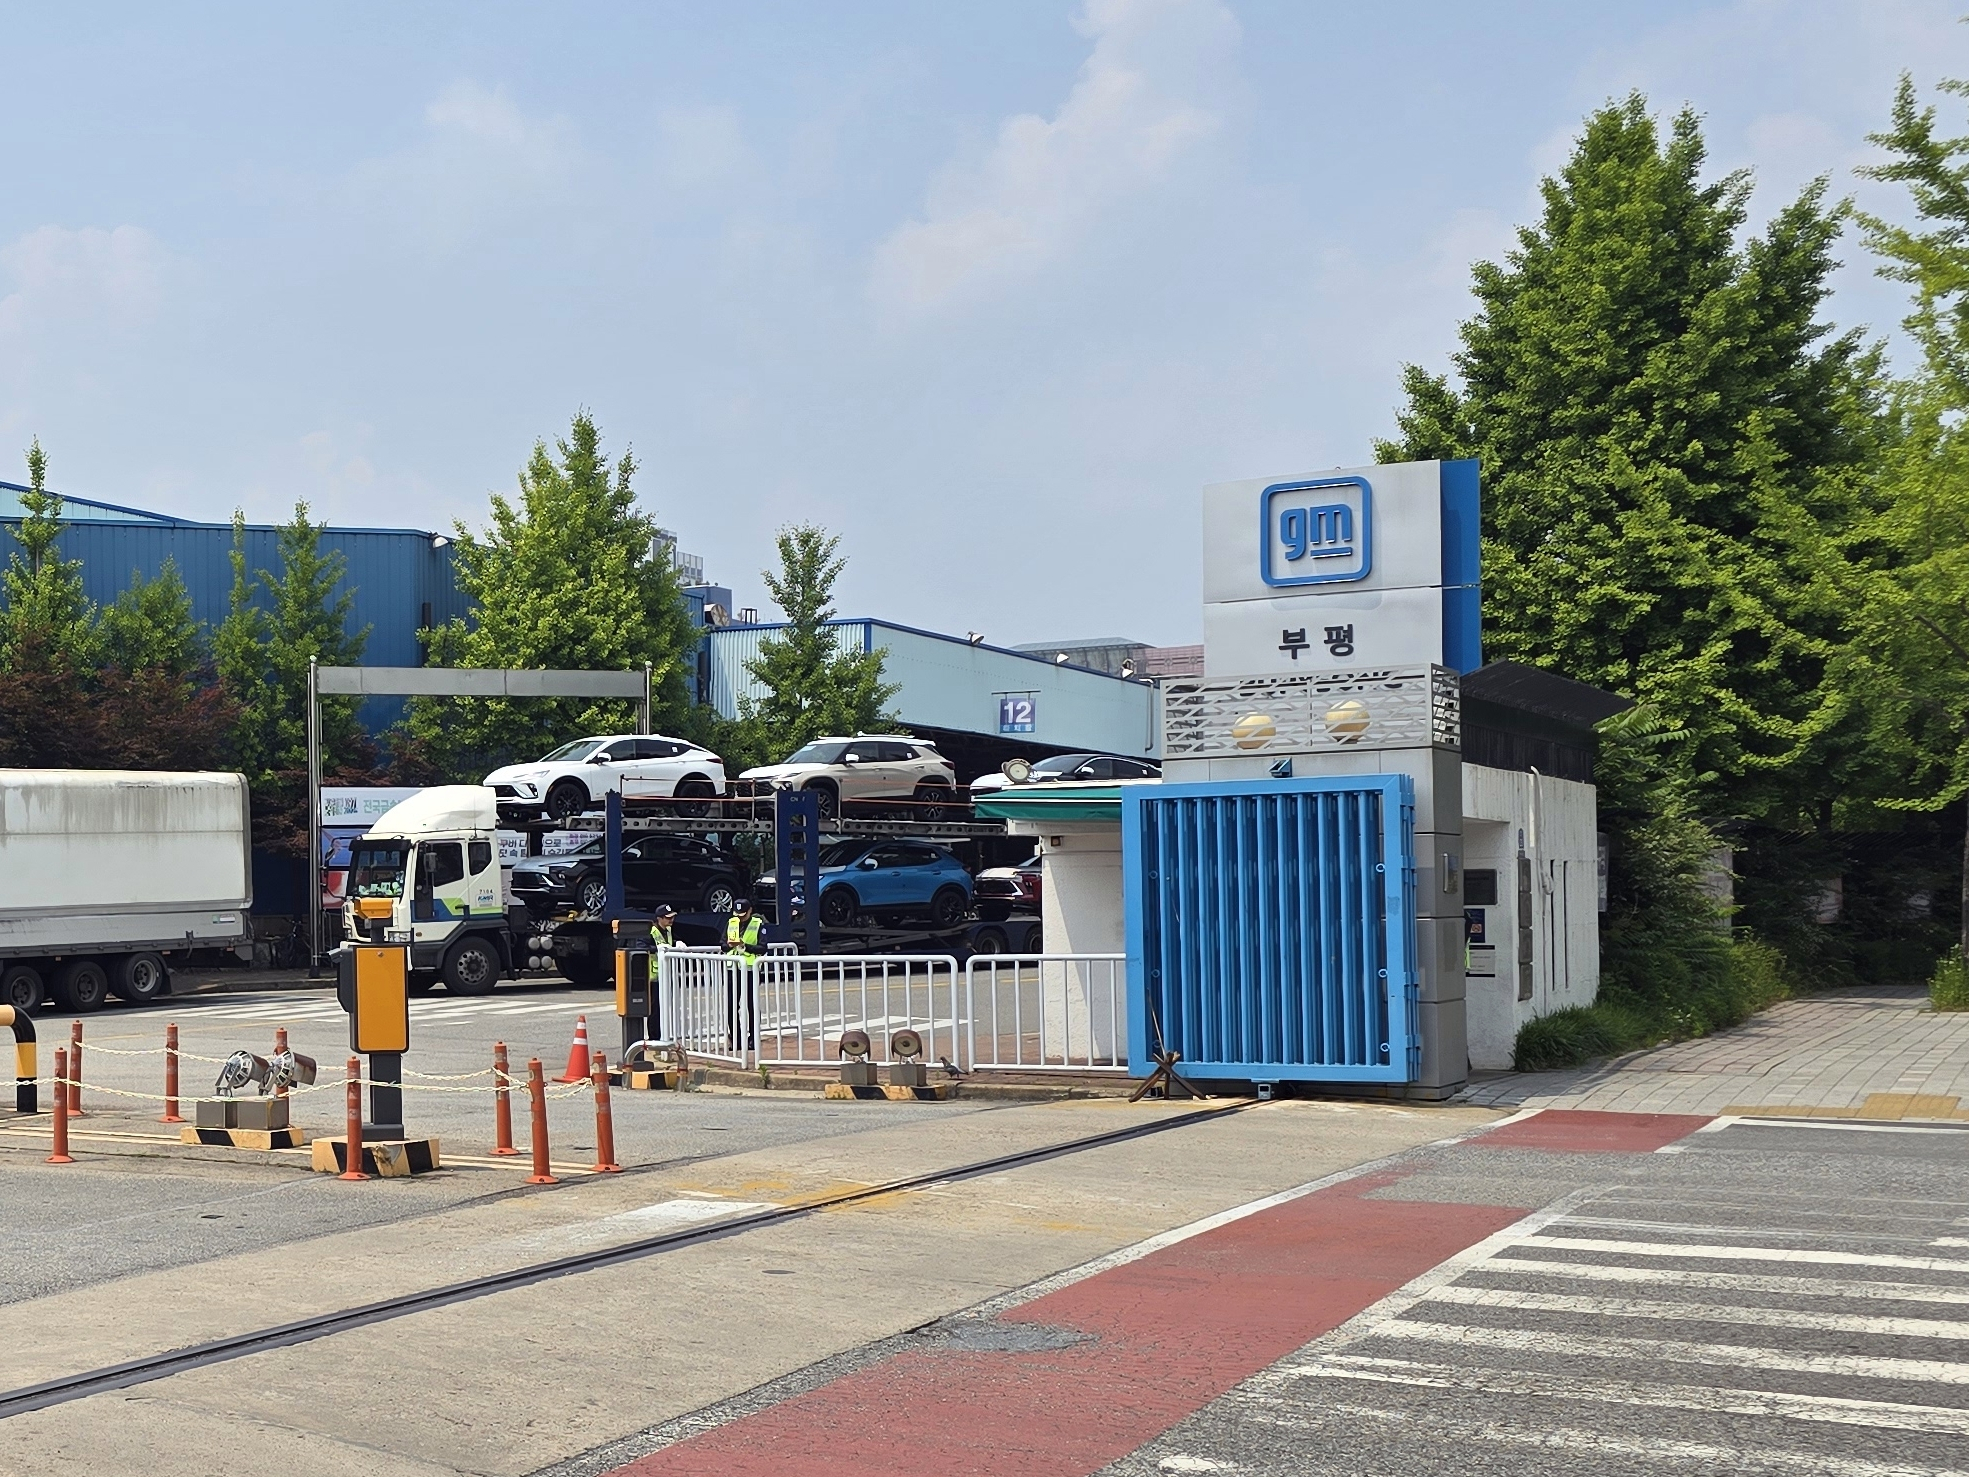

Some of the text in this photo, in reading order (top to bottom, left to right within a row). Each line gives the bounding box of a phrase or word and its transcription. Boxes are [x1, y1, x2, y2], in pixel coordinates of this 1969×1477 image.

[1280, 504, 1353, 561] gm
[1279, 624, 1354, 660] 부평
[1004, 701, 1031, 723] 12
